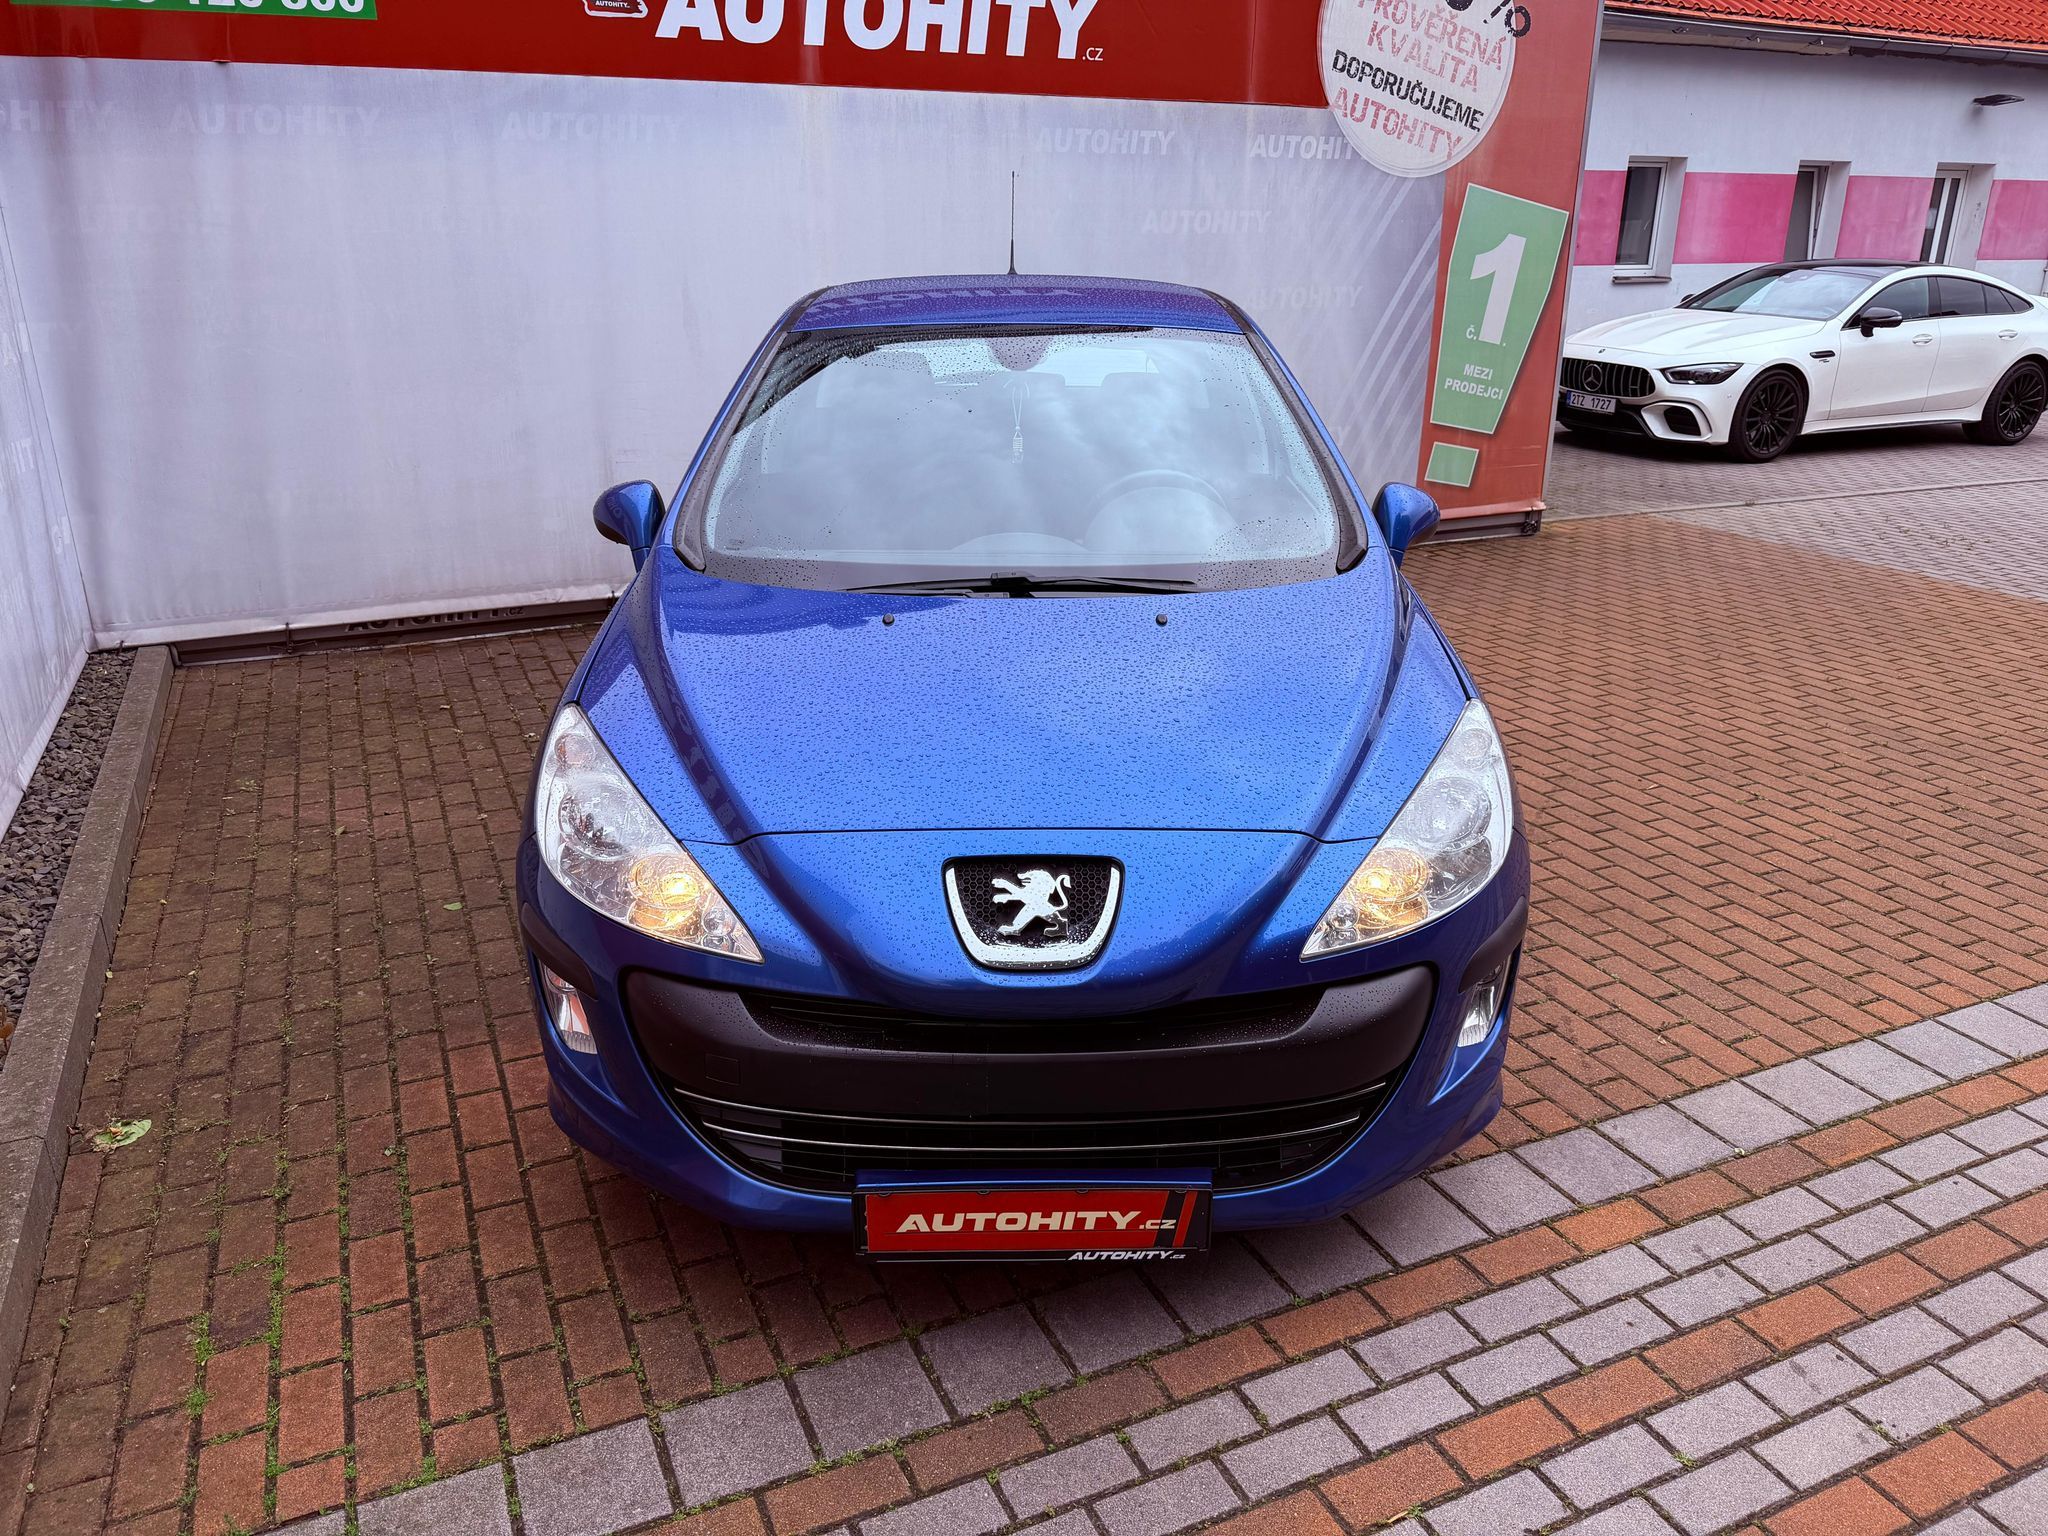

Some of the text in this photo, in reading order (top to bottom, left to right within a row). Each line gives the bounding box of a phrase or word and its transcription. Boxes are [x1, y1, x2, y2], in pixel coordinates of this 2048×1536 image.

[1367, 20, 1479, 91] KVALITA
[1331, 48, 1484, 132] DOPORUČUJEME
[1330, 86, 1464, 161] AUTOHITY
[1035, 126, 1176, 156] AUTOHITY
[1250, 134, 1366, 160] AUTOHIT
[1140, 208, 1272, 235] AUTOHITY
[1463, 363, 1493, 380] MEZI
[1444, 377, 1504, 400] PRODEJCI
[1571, 394, 1612, 411] 2TZ 1727
[896, 1210, 1177, 1233] AUTOHITY.cz
